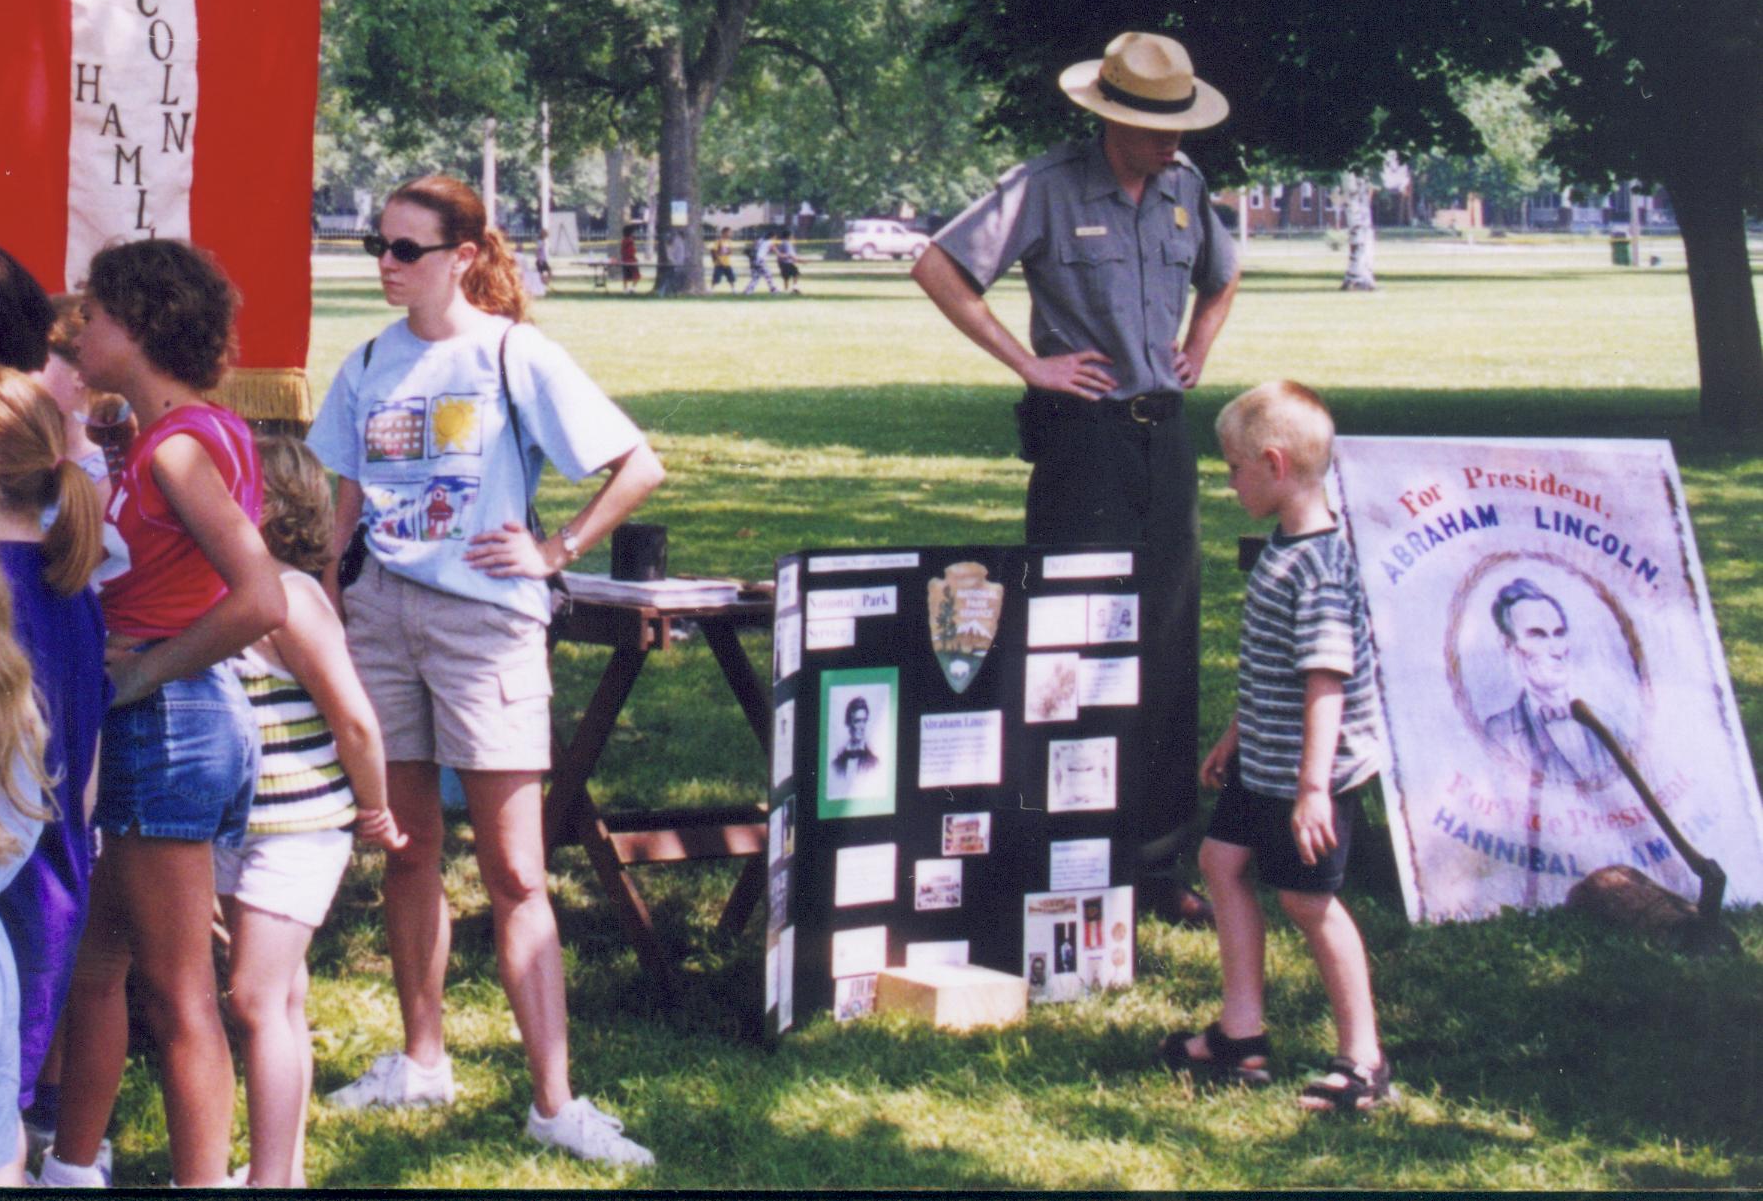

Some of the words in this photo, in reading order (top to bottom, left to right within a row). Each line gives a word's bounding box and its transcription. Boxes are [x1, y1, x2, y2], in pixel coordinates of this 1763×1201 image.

[1398, 482, 1445, 520] For
[1380, 503, 1500, 586] ABRAHAM
[861, 592, 889, 608] Park
[1433, 805, 1586, 878] HANNIBAL
